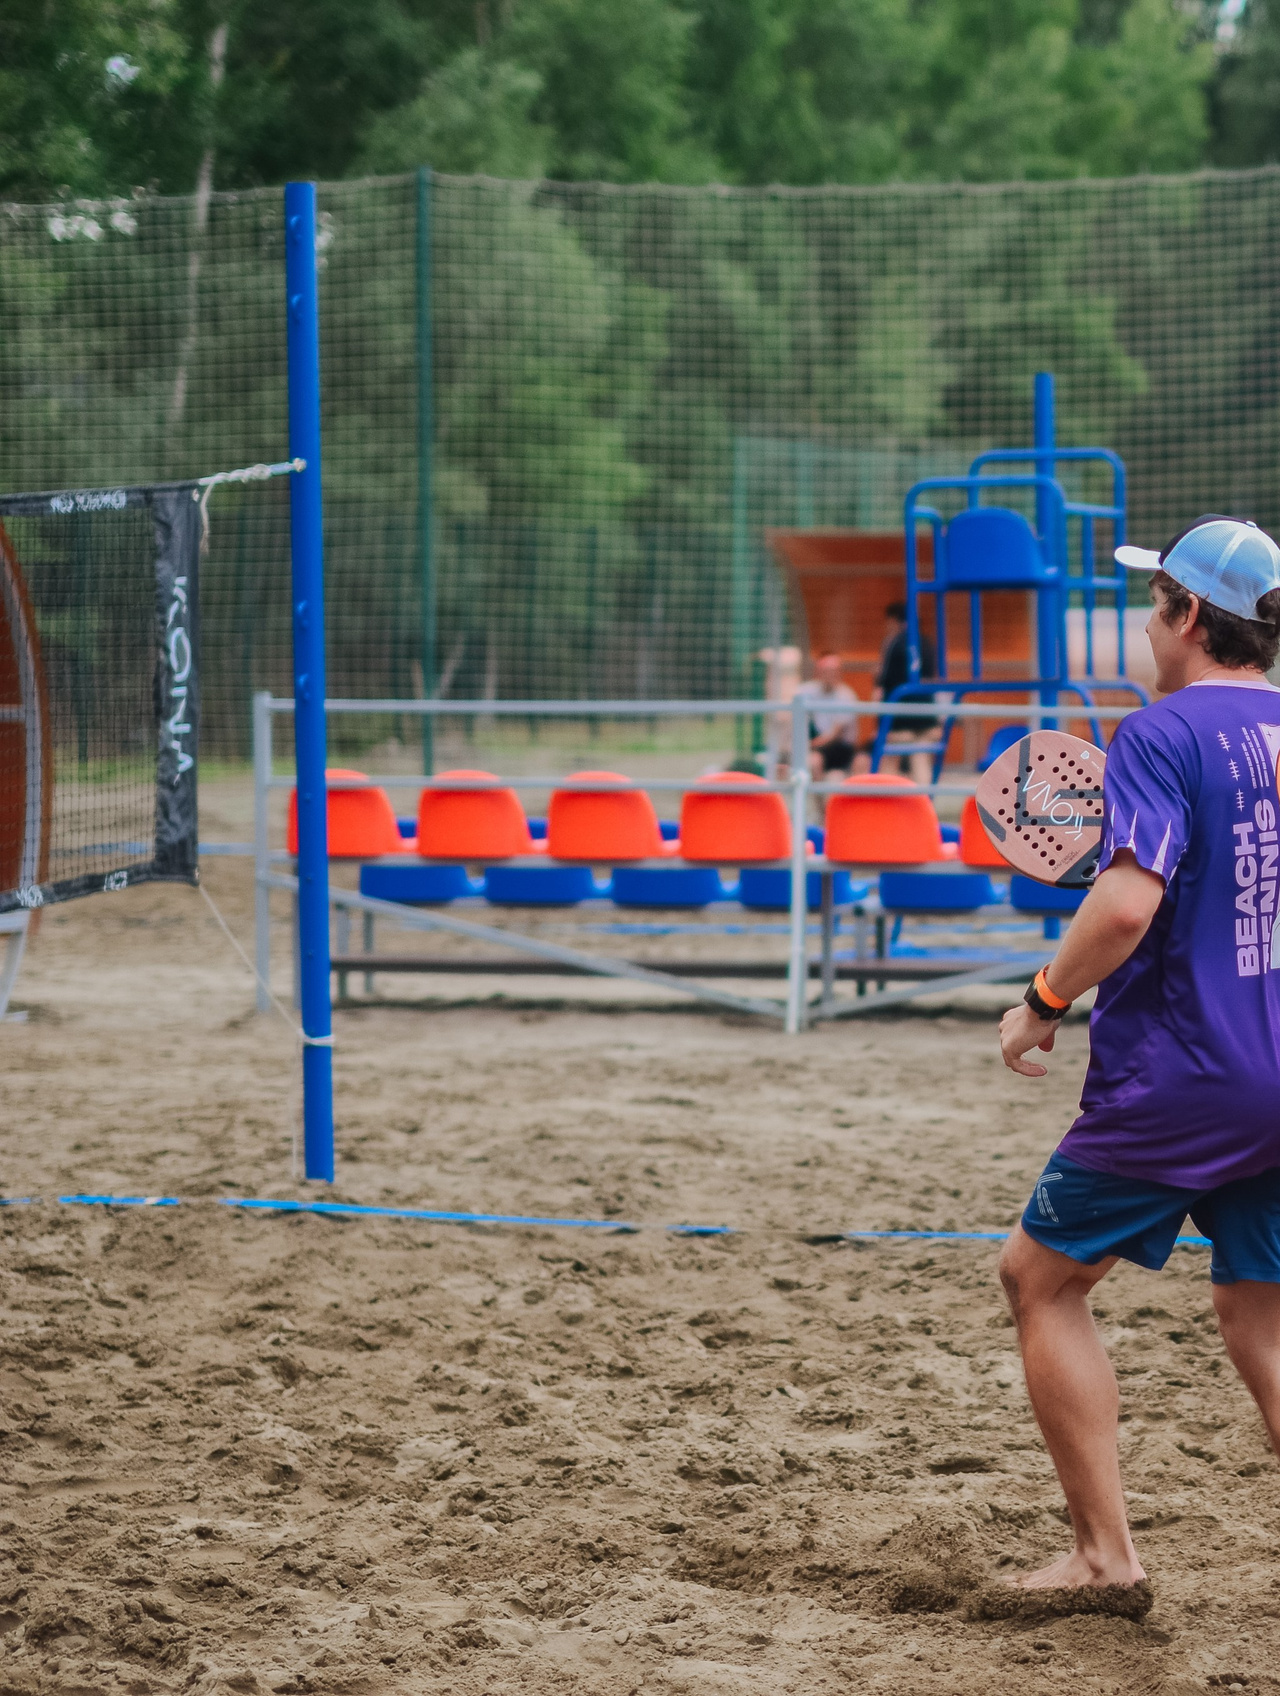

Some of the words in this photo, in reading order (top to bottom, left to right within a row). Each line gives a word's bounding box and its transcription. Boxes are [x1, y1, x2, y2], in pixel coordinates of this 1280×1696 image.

[167, 576, 194, 785] KONA
[1023, 769, 1083, 841] KONA
[1255, 798, 1279, 975] TENNIS
[1233, 821, 1260, 977] BEACH
